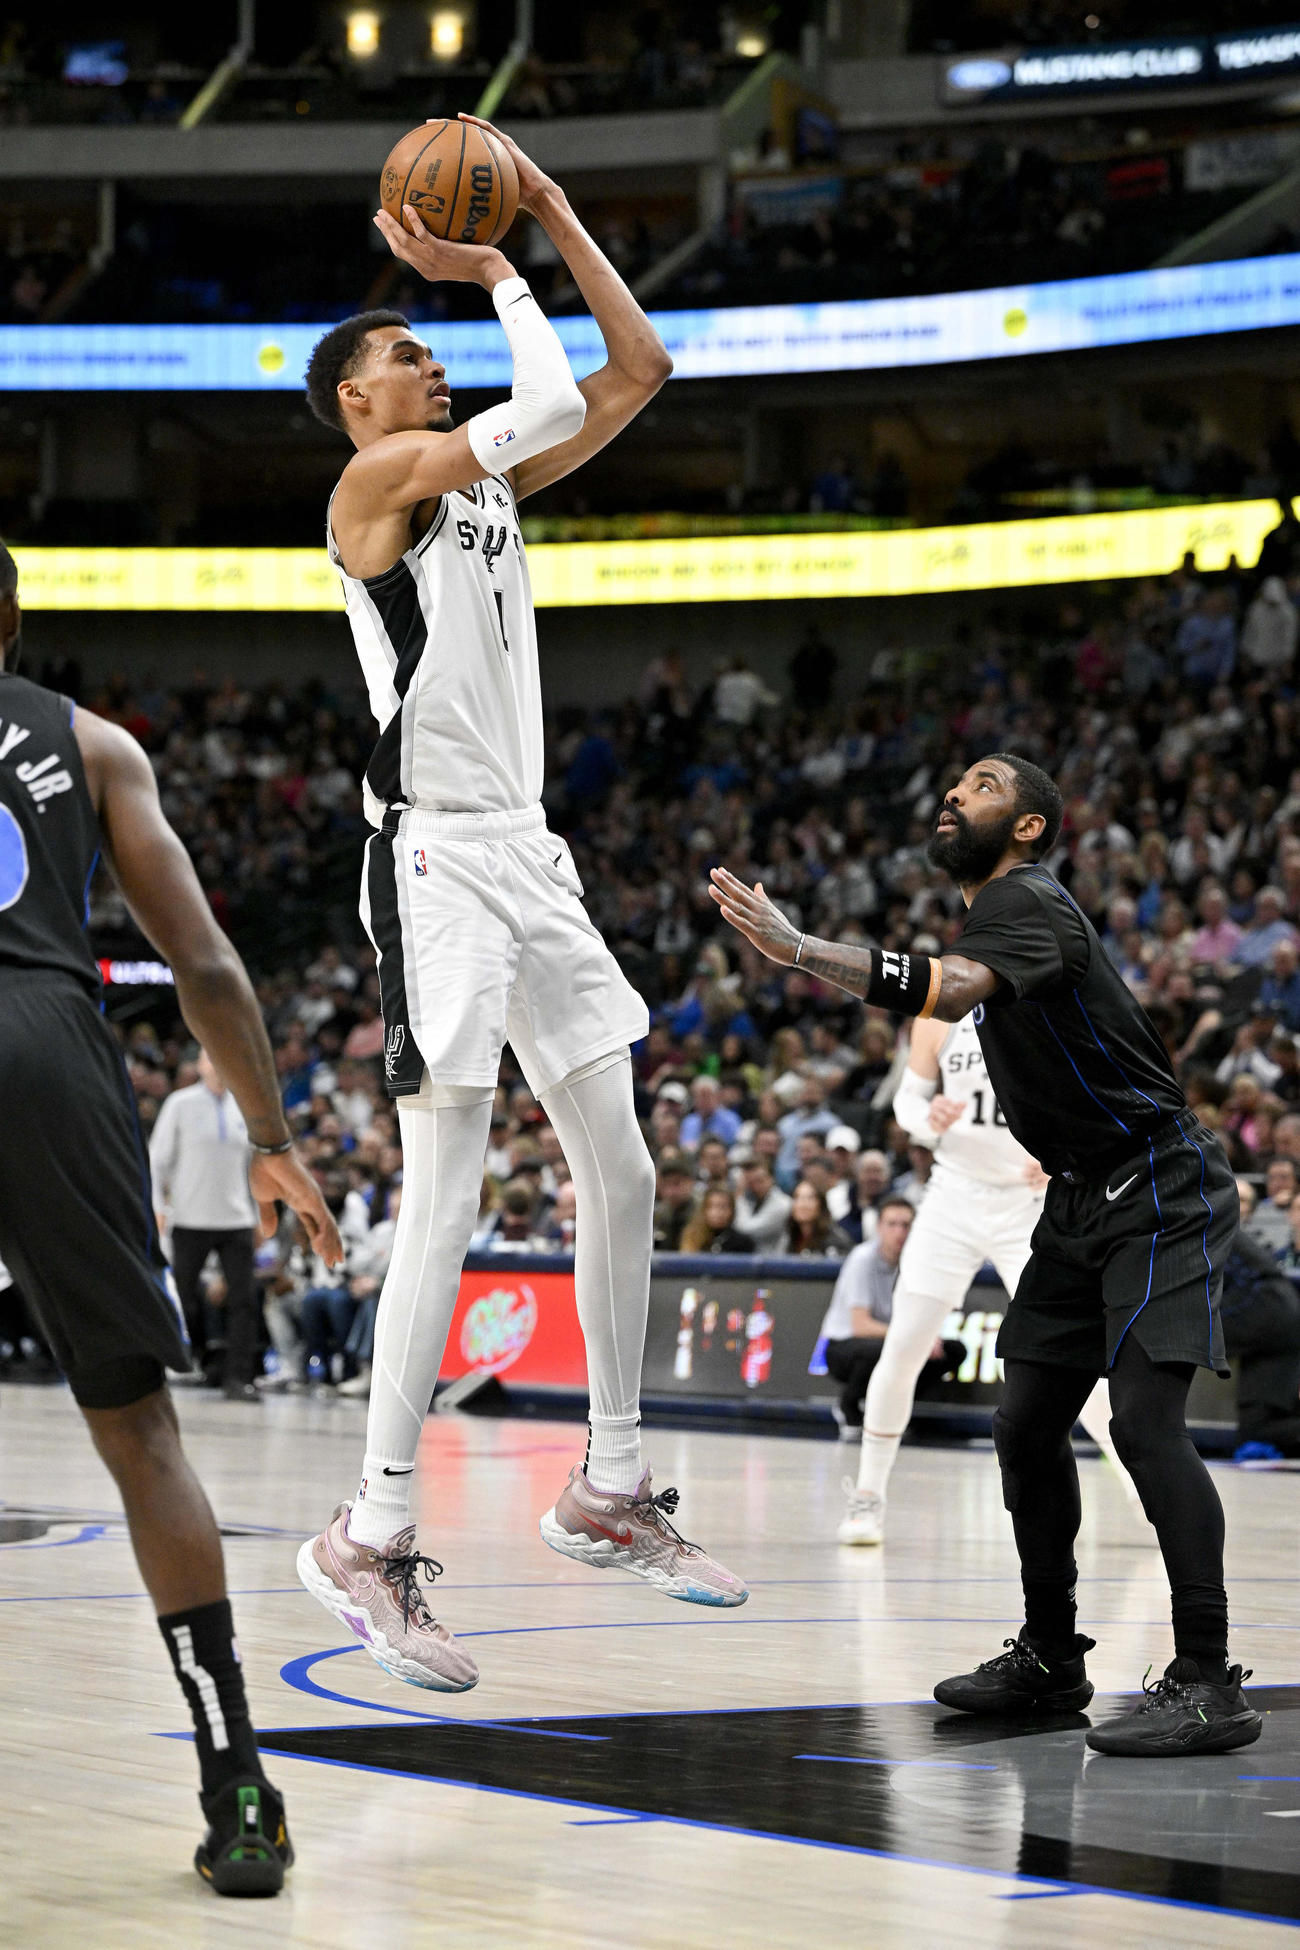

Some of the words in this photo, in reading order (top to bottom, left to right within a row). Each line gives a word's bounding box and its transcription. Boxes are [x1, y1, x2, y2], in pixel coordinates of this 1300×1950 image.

[461, 162, 494, 243] Wilso
[0, 717, 31, 760] Y
[15, 753, 73, 814] JR.
